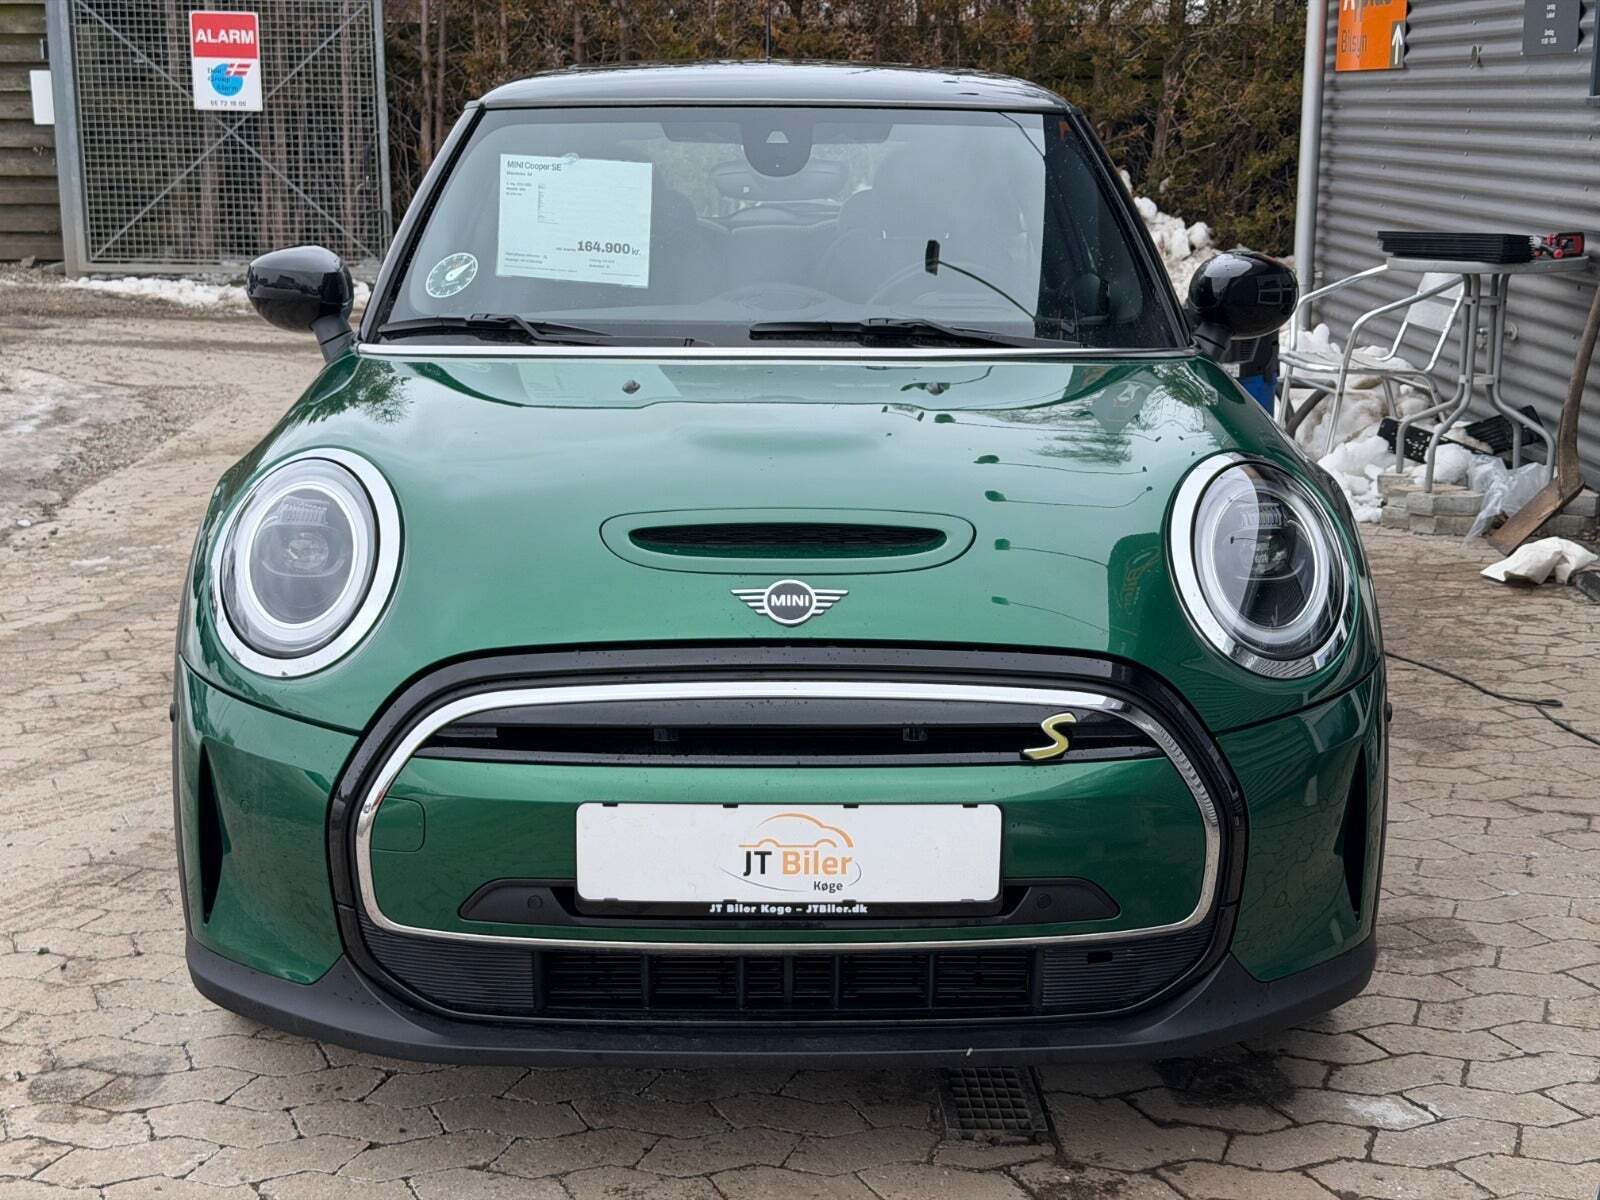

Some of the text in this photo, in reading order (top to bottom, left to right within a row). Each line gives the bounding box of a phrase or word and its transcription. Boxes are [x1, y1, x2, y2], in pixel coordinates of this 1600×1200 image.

[195, 28, 255, 45] ALARM
[1341, 28, 1367, 58] Bilsyn
[507, 160, 562, 172] MINI Cooper SE
[577, 240, 630, 255] 164.900
[631, 247, 641, 256] kr.
[770, 594, 809, 607] MINI
[1023, 712, 1077, 760] S
[743, 850, 853, 876] JT Biler
[813, 880, 843, 894] Køge
[709, 904, 722, 913] JT
[726, 904, 756, 913] Biler
[806, 904, 868, 913] JTBiler.dk
